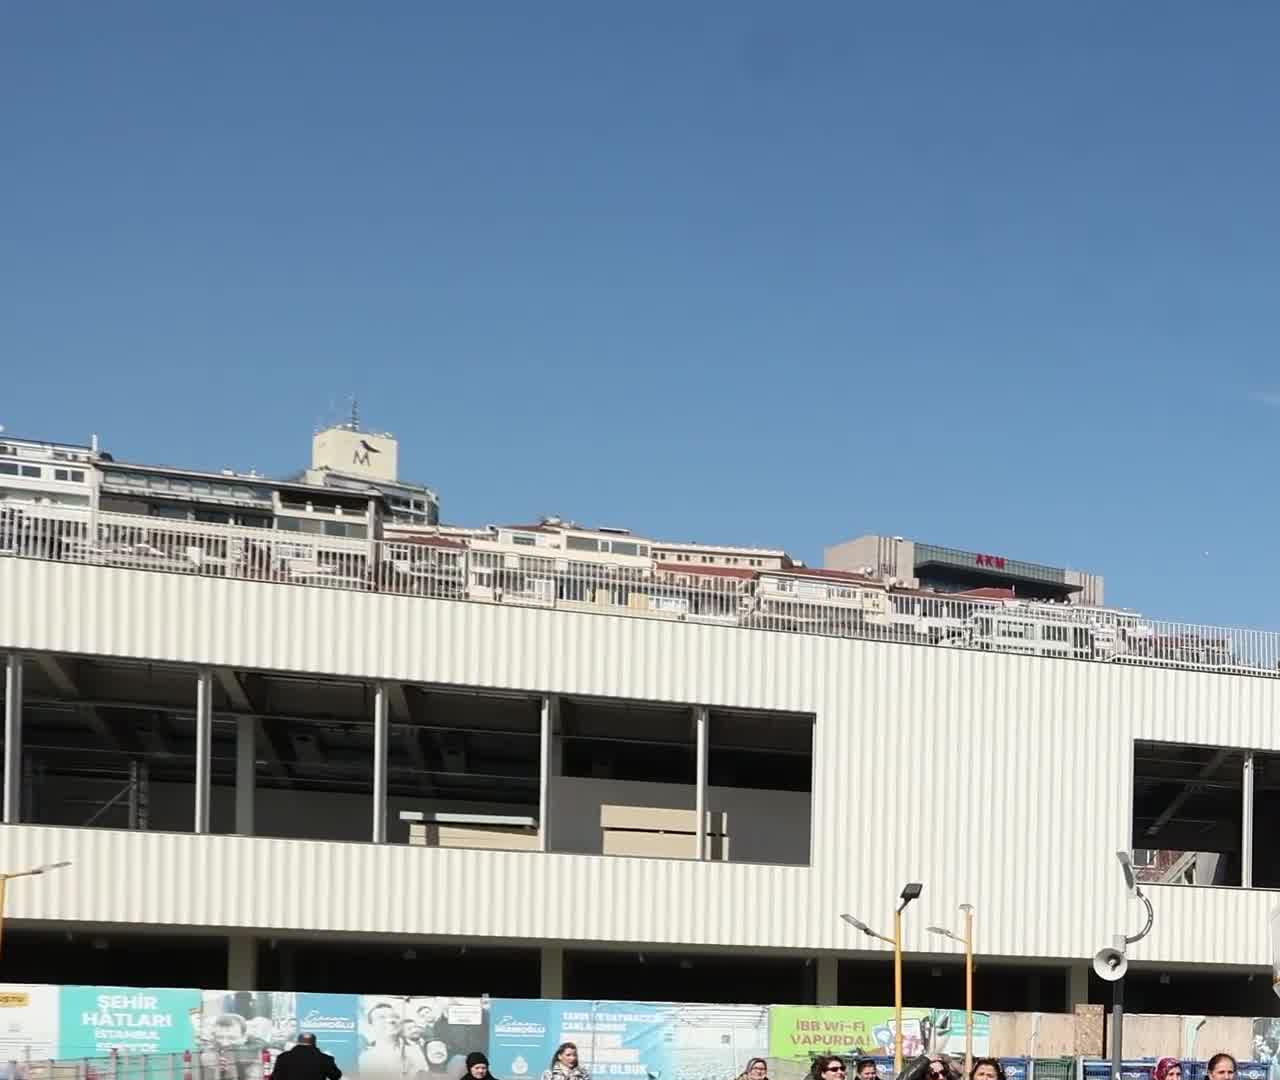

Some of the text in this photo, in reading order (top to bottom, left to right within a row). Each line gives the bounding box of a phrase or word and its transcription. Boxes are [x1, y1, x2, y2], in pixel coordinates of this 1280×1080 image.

[976, 553, 1005, 569] AKM
[96, 991, 159, 1011] ŞEHİR
[81, 1011, 173, 1027] HATLARI
[824, 1020, 865, 1033] Wi-Fi
[790, 1033, 870, 1047] VAPURDA!
